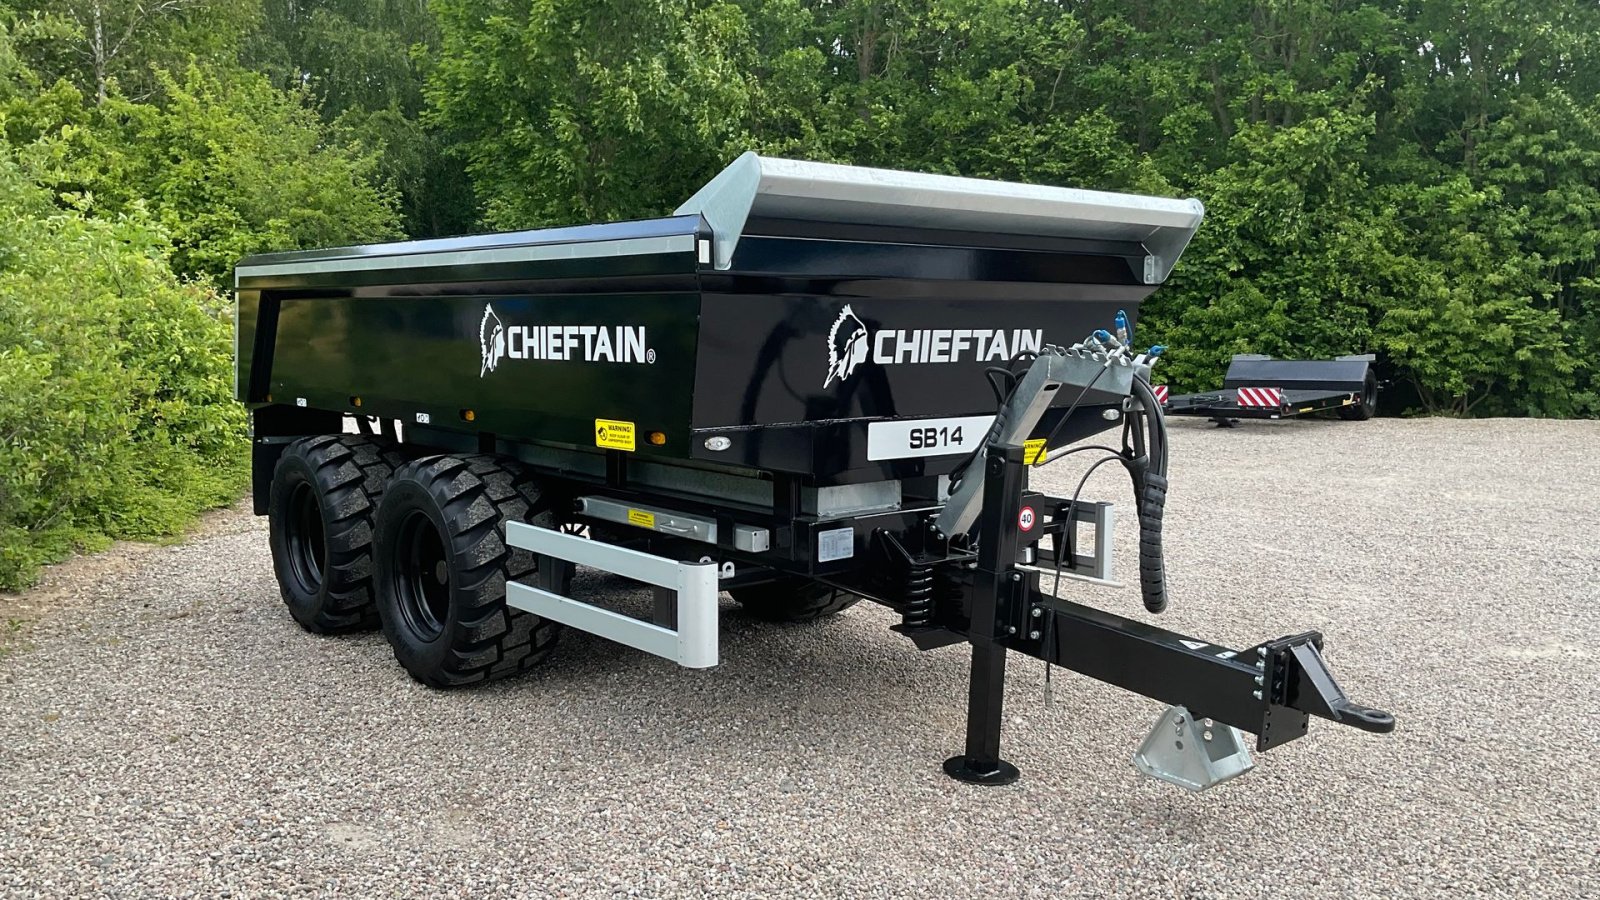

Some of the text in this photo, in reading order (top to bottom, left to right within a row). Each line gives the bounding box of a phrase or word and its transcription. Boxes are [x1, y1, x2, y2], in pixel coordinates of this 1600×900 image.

[873, 329, 1043, 365] CHIEFTAIN
[909, 425, 963, 449] SB14
[1021, 513, 1032, 524] 40
